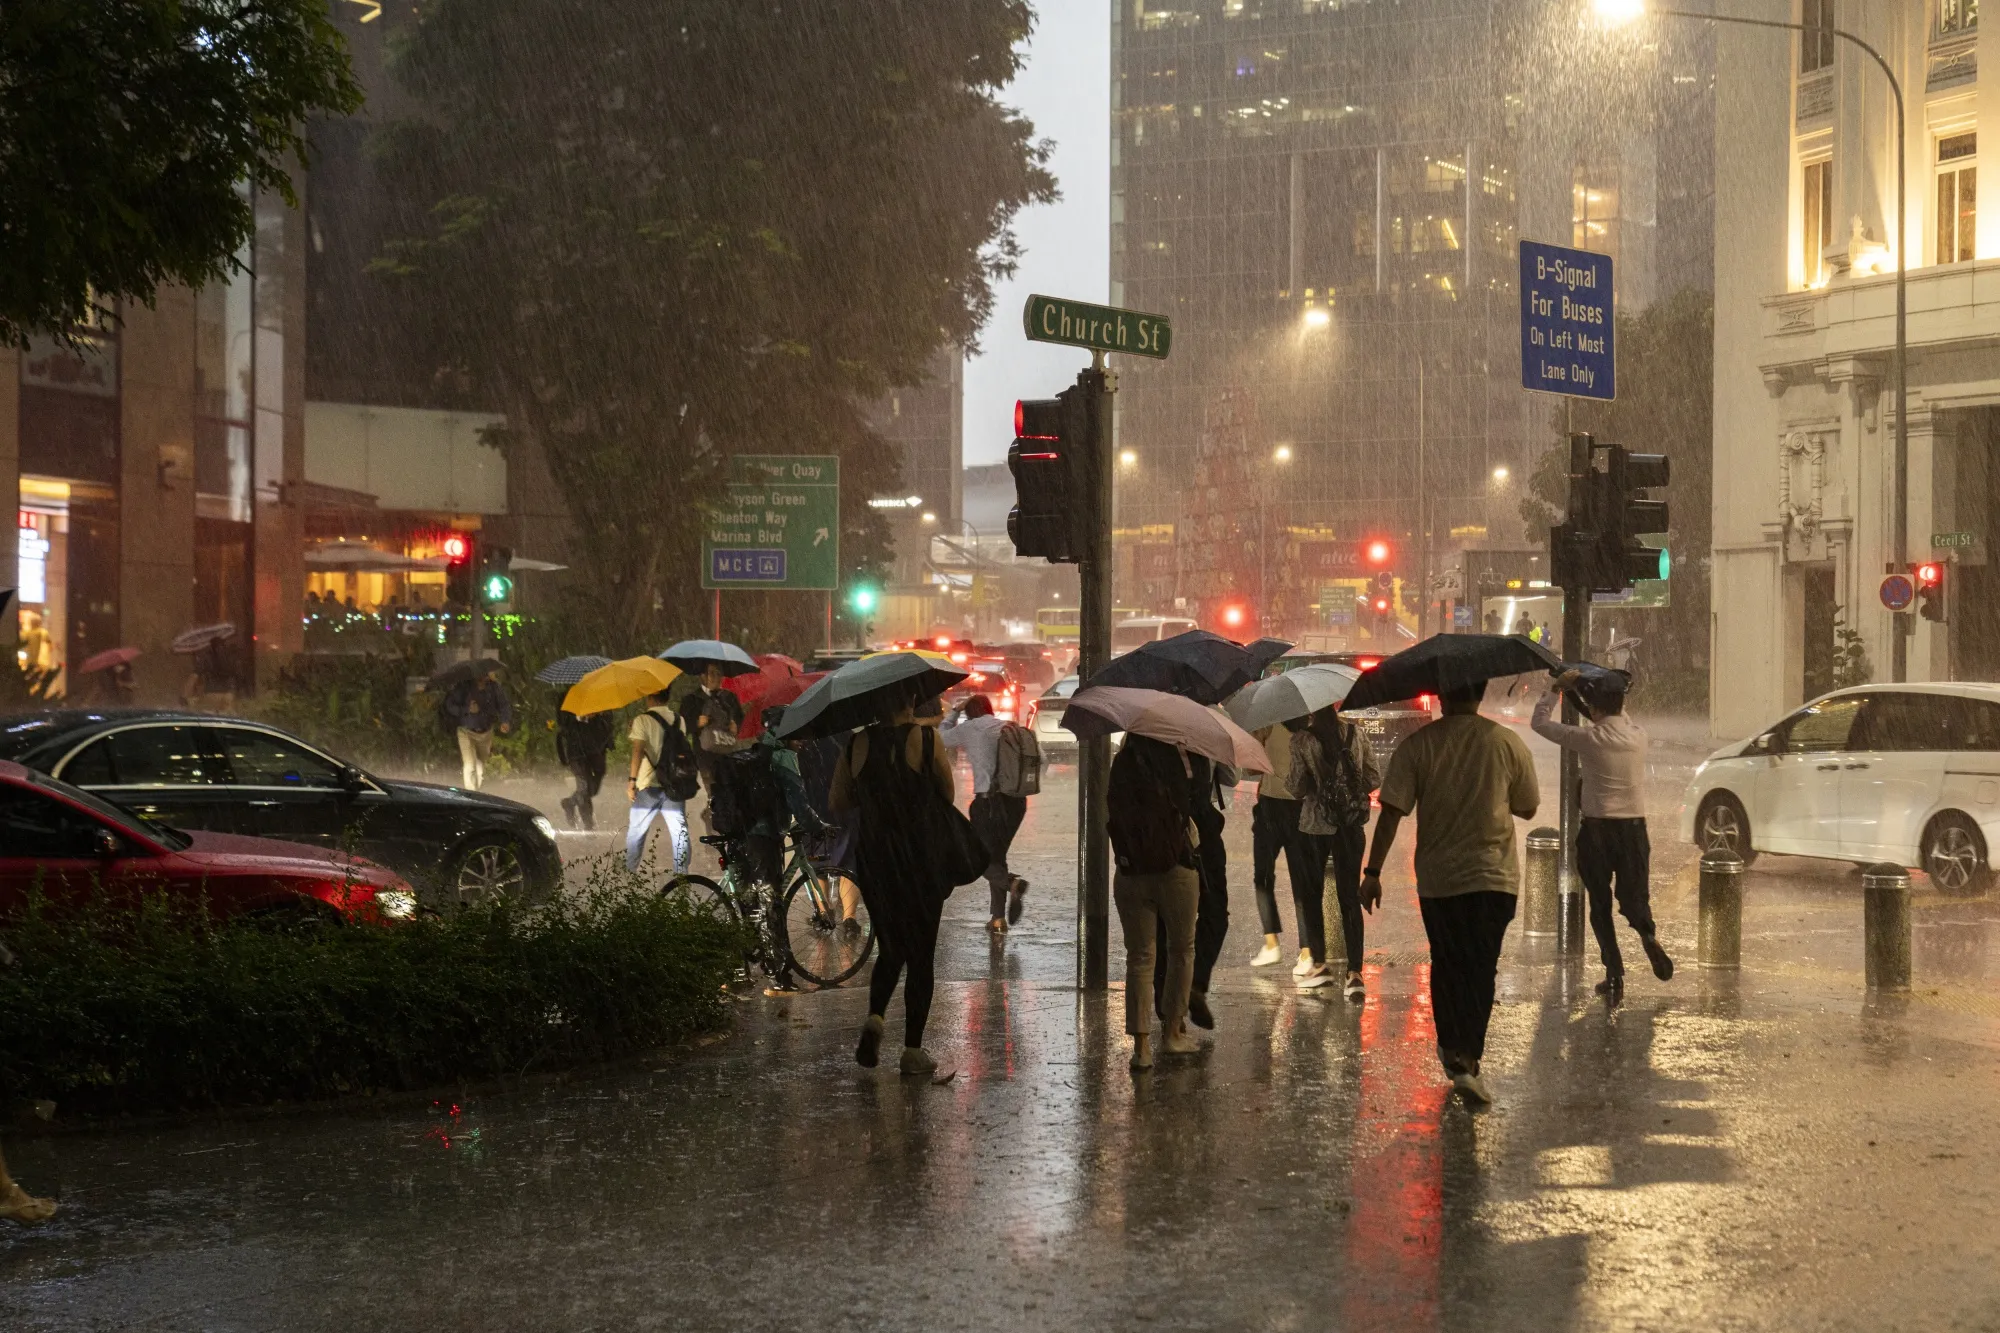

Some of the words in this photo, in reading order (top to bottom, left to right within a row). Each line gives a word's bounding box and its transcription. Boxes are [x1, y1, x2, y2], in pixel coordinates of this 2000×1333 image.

[1537, 255, 1596, 292] B-Signal
[1531, 290, 1554, 317] For
[1562, 295, 1603, 325] Buses
[1043, 303, 1127, 346] Church
[1138, 319, 1160, 351] St
[1530, 326, 1544, 346] On
[1550, 328, 1573, 350] Left
[1578, 333, 1605, 355] Most
[1541, 359, 1566, 380] Lane
[1571, 363, 1595, 389] Only
[792, 462, 822, 480] Quay
[772, 491, 806, 506] Green
[711, 510, 758, 524] Shenton
[765, 511, 788, 528] Way
[758, 529, 783, 543] Blvd
[1935, 534, 1958, 547] Cecil
[1961, 533, 1970, 546] St
